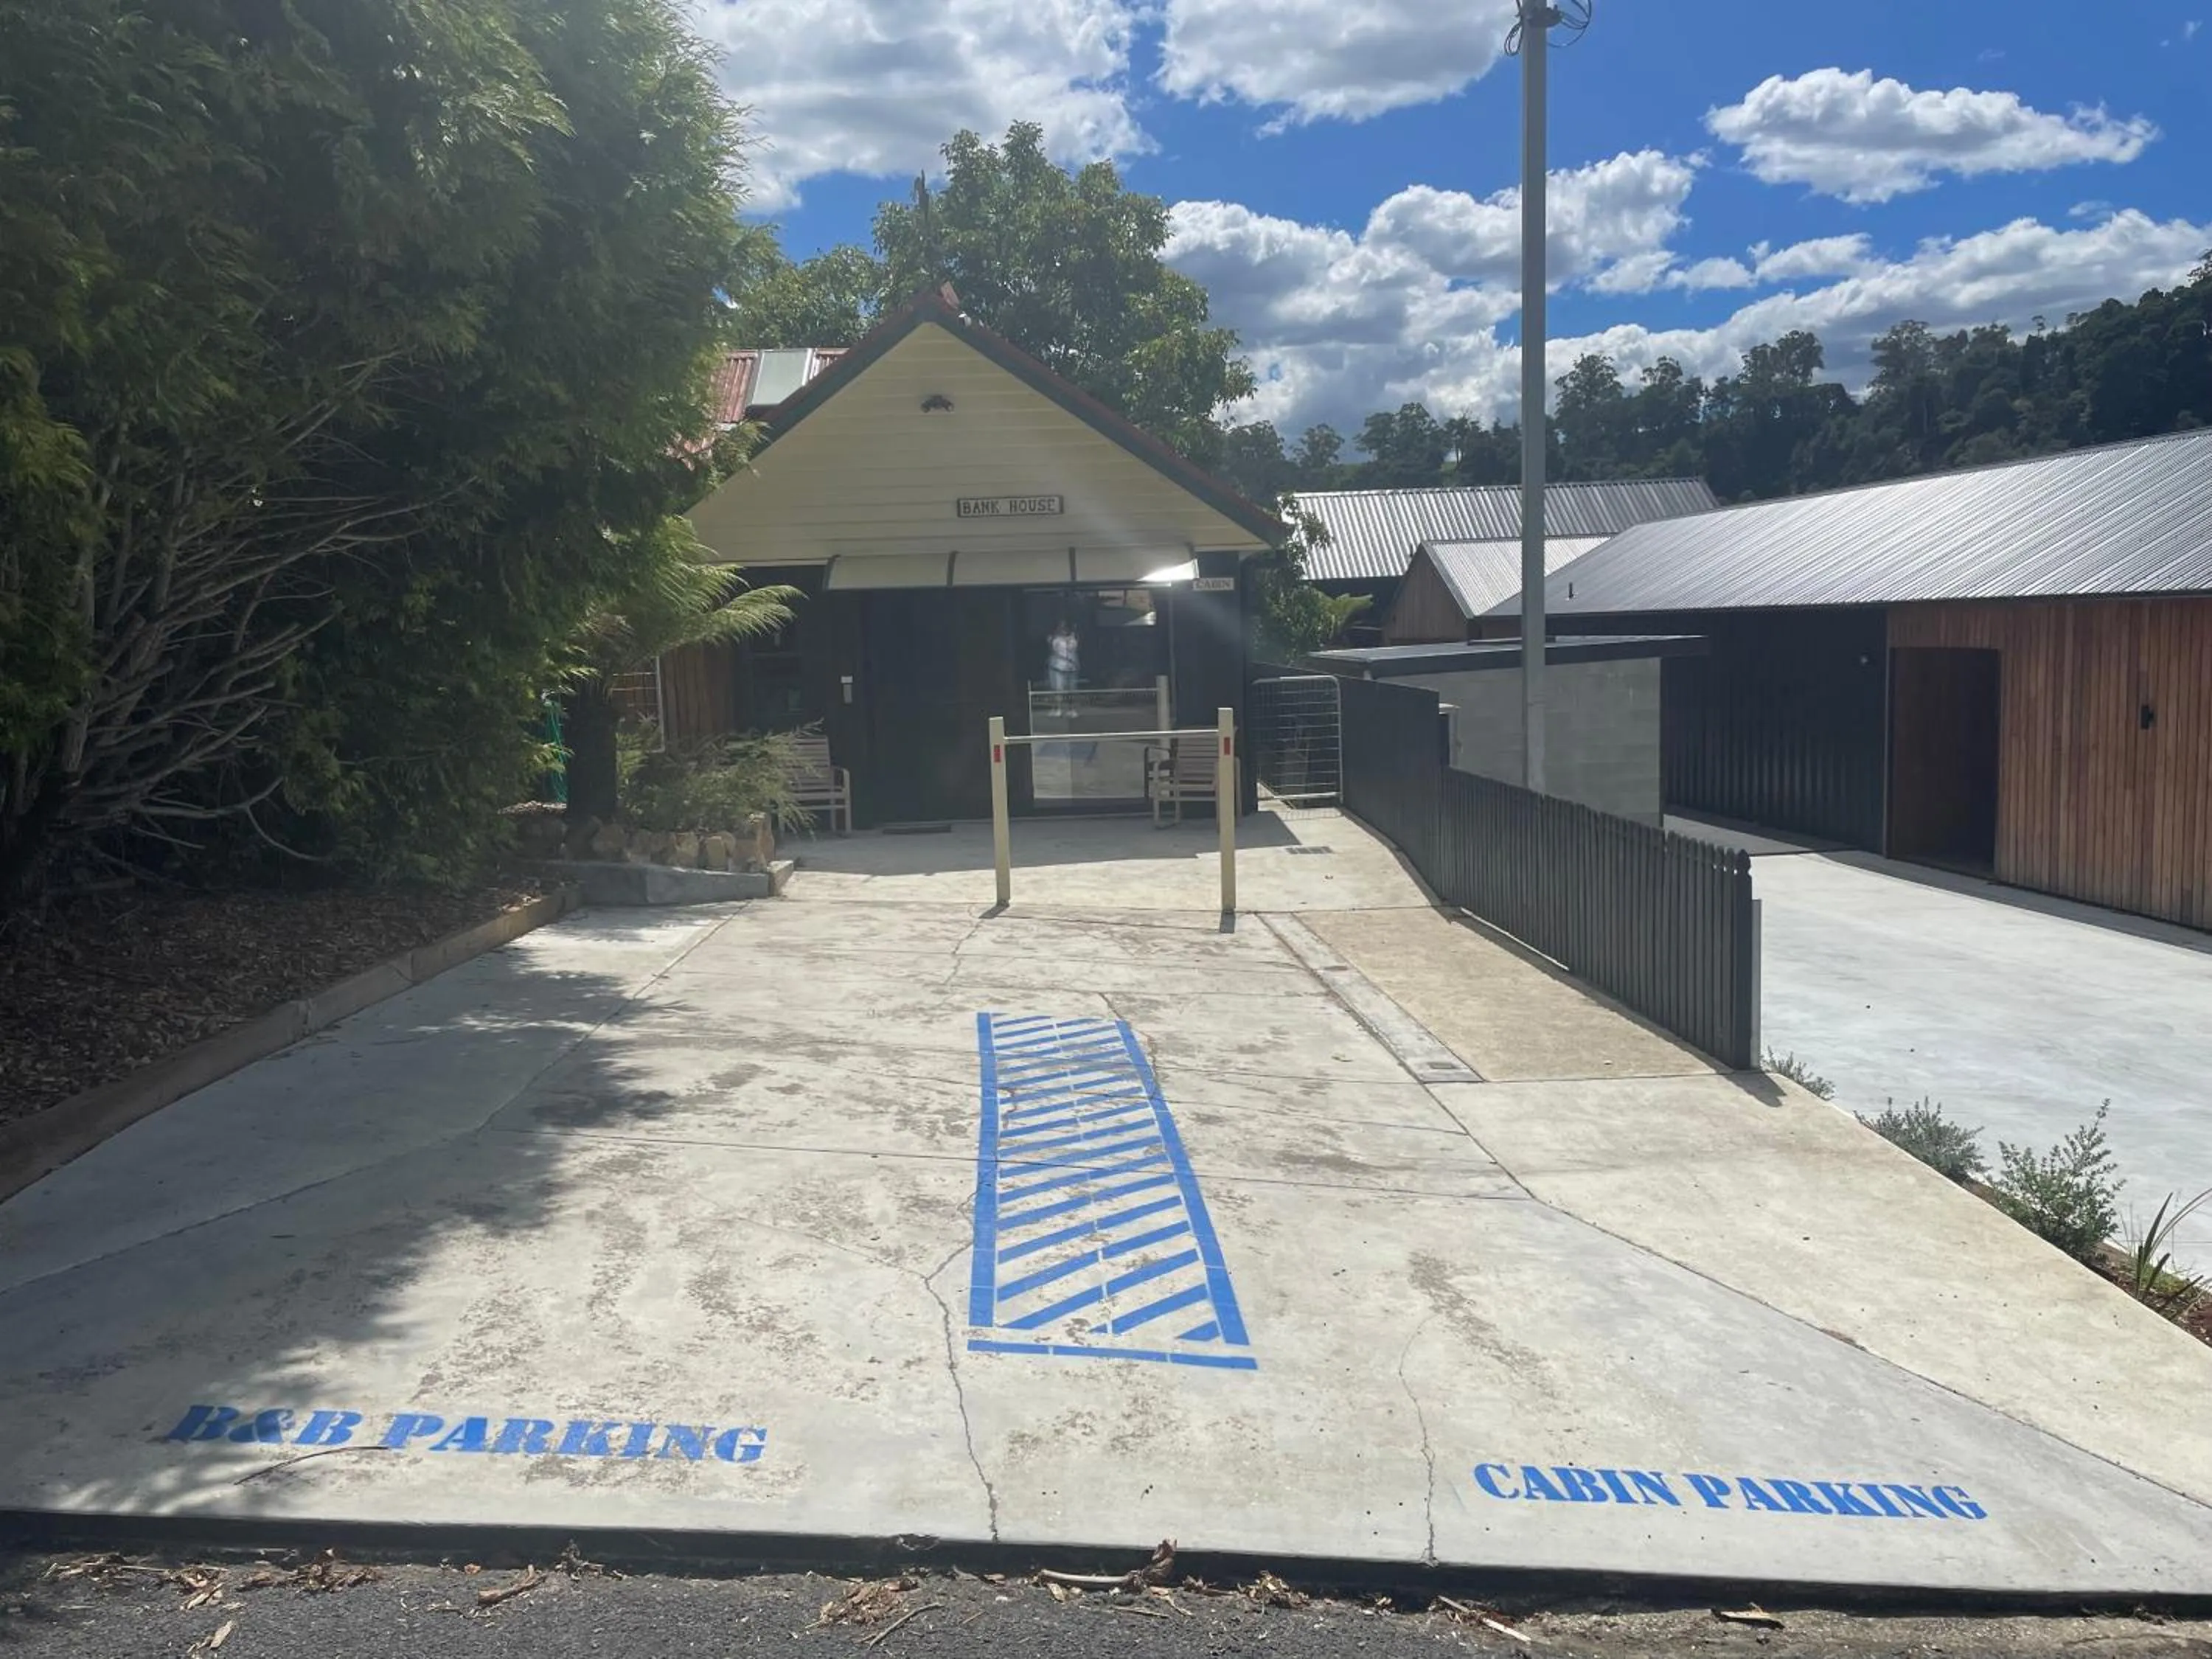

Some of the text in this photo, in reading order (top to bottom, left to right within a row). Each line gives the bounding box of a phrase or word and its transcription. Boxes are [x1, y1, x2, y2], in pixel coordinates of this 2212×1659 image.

[962, 498, 1056, 515] BANK HOUSE
[166, 1405, 768, 1463] B&B PARKING
[1474, 1462, 1988, 1520] CABIN PARKING
